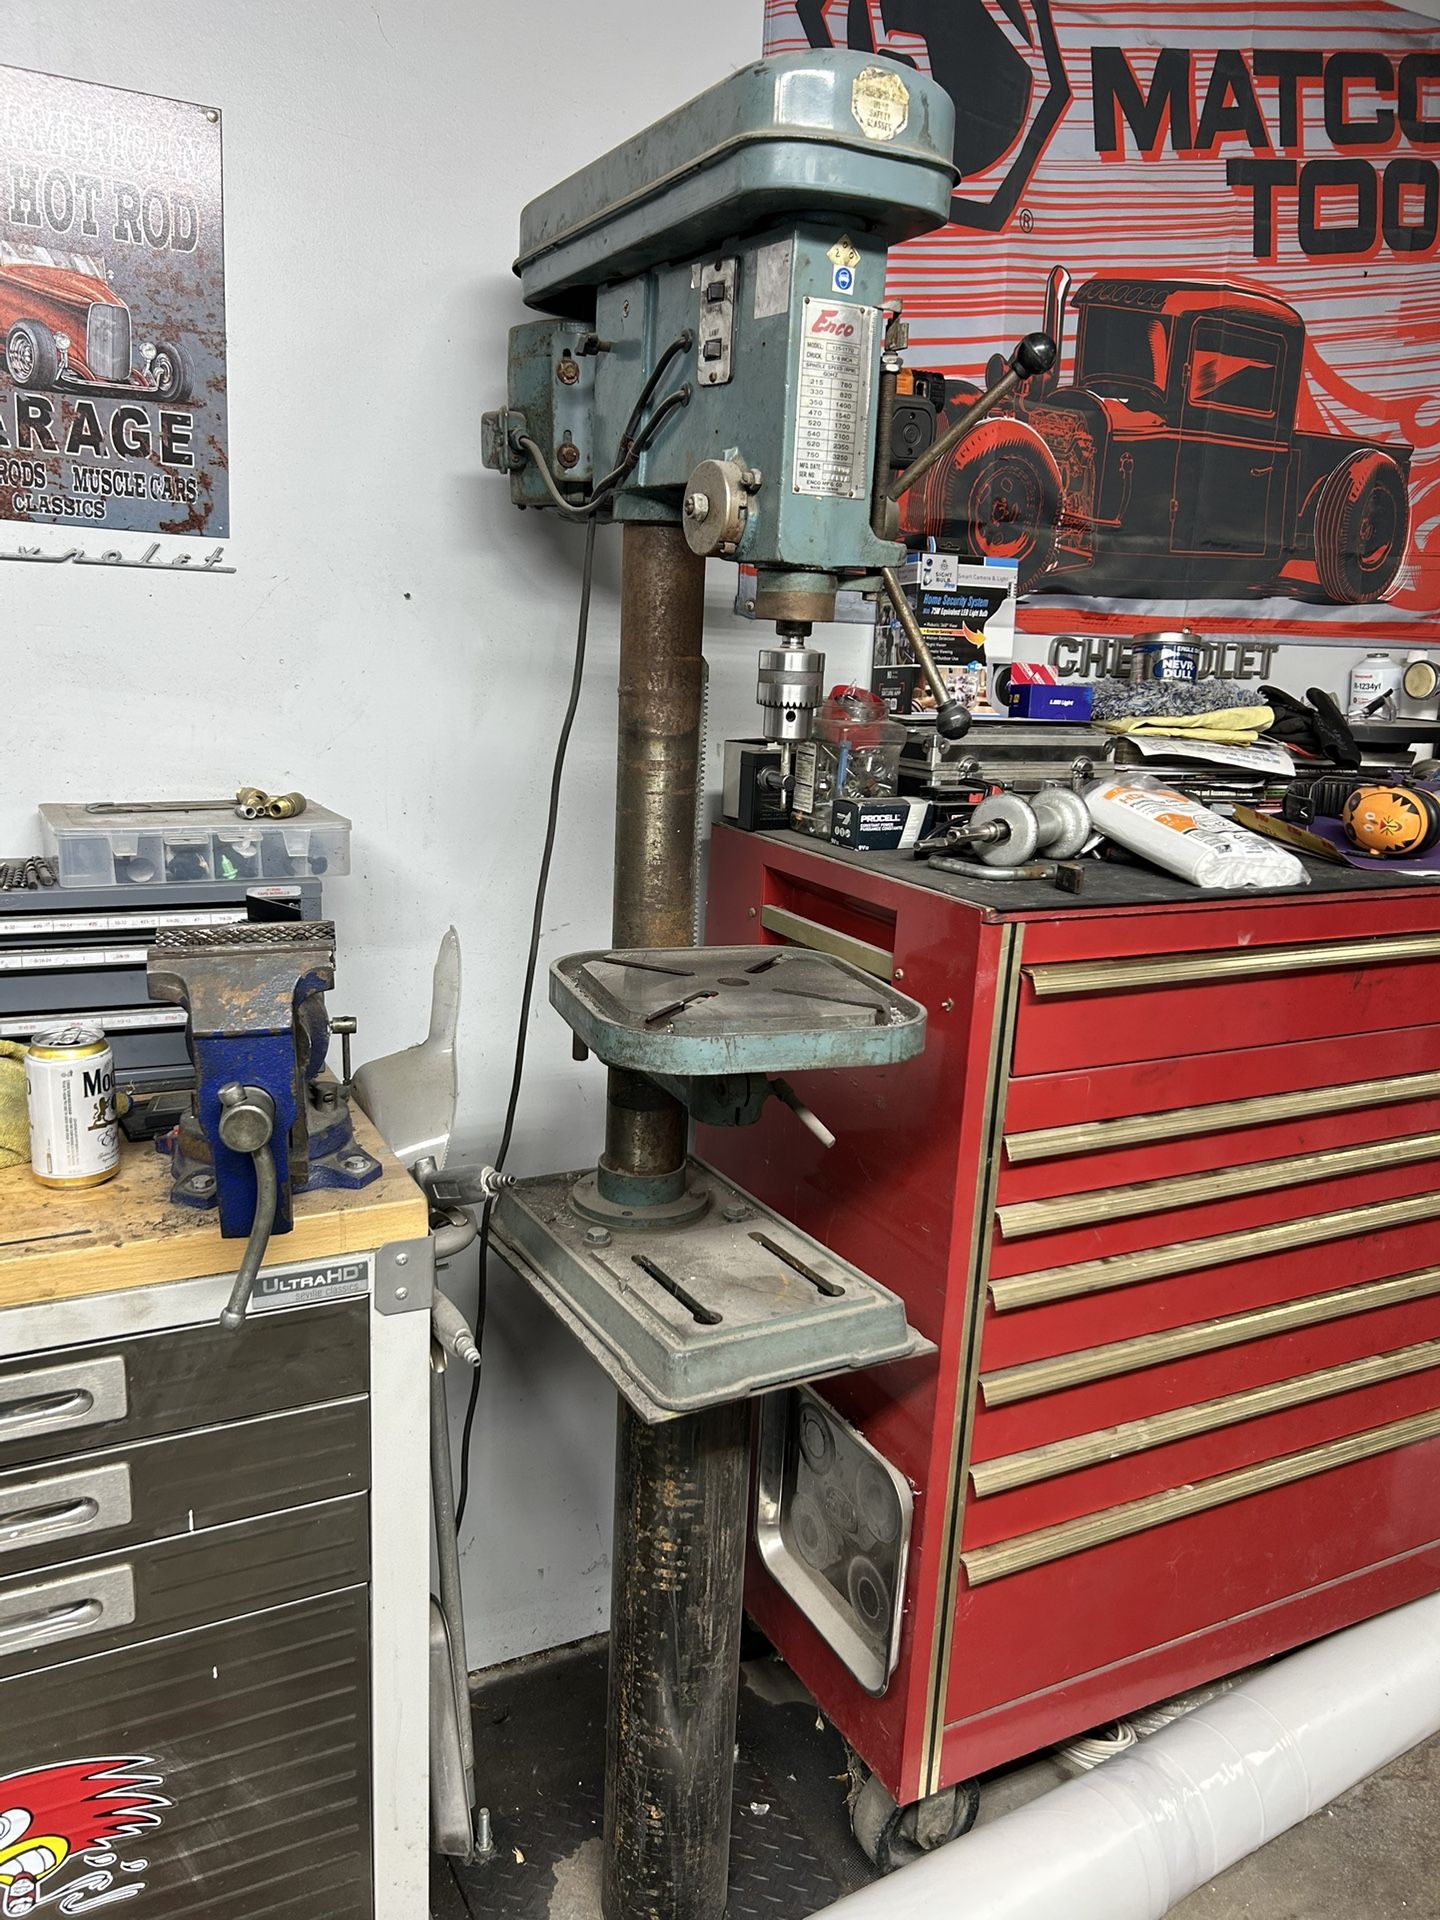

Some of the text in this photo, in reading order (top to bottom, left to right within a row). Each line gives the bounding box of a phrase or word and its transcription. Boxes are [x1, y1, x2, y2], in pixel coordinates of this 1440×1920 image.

[8, 160, 199, 254] HOT ROD
[0, 392, 195, 468] RAGE
[835, 422, 850, 430] 1700
[834, 433, 850, 441] 2100
[72, 465, 147, 499] MUSCLE
[150, 475, 199, 505] CARS
[14, 494, 106, 520] CLASSICS
[923, 593, 989, 608] Home Security System
[1163, 669, 1192, 679] DULL
[861, 814, 900, 822] PROCELL
[295, 1283, 359, 1301] seville classics
